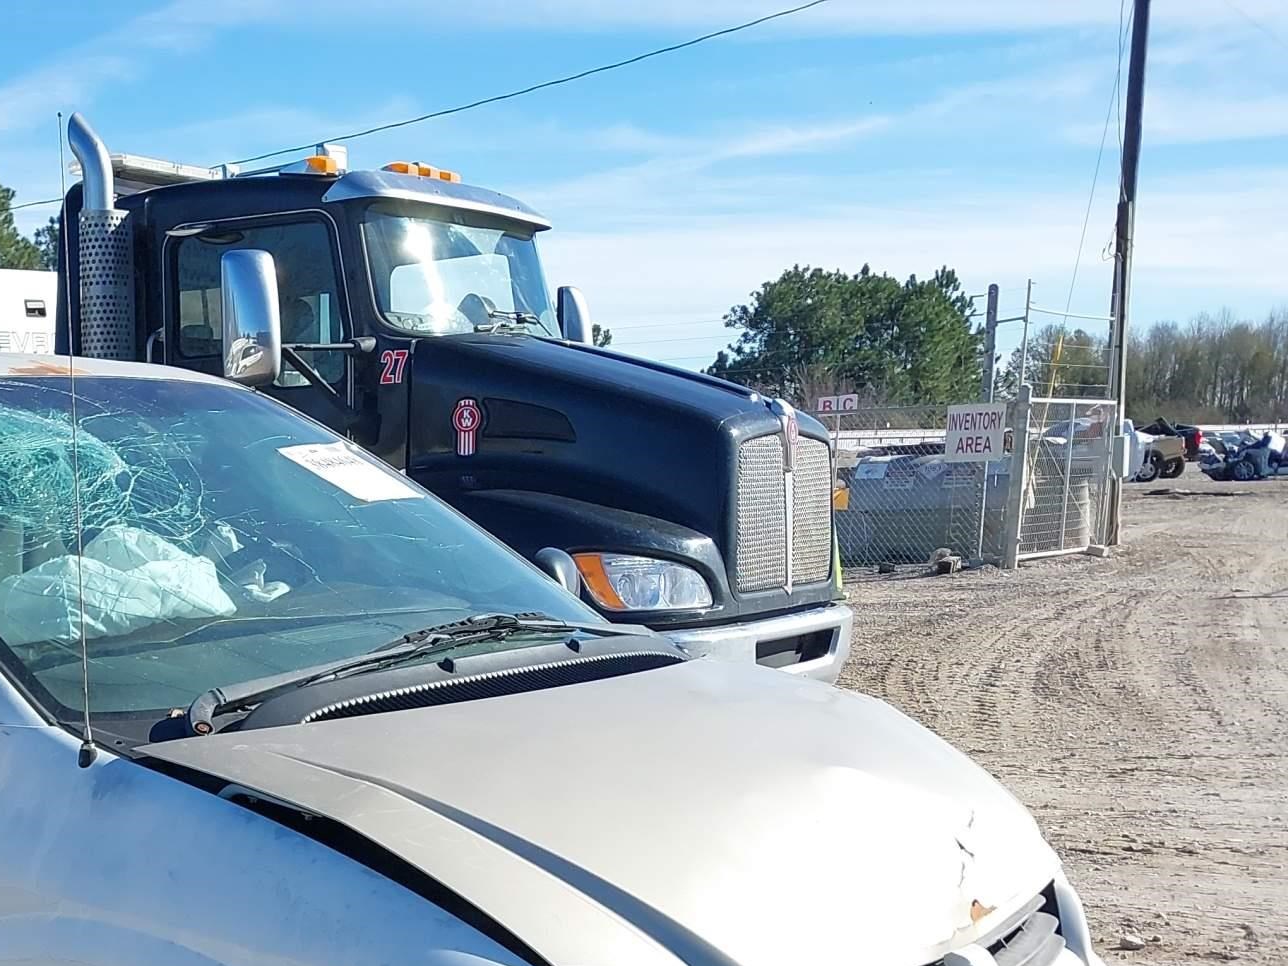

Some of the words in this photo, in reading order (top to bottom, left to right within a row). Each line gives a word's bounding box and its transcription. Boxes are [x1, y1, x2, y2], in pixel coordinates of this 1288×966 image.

[380, 350, 409, 385] 27
[843, 398, 854, 410] C
[948, 411, 1004, 431] INVENTORY
[955, 436, 992, 454] AREA
